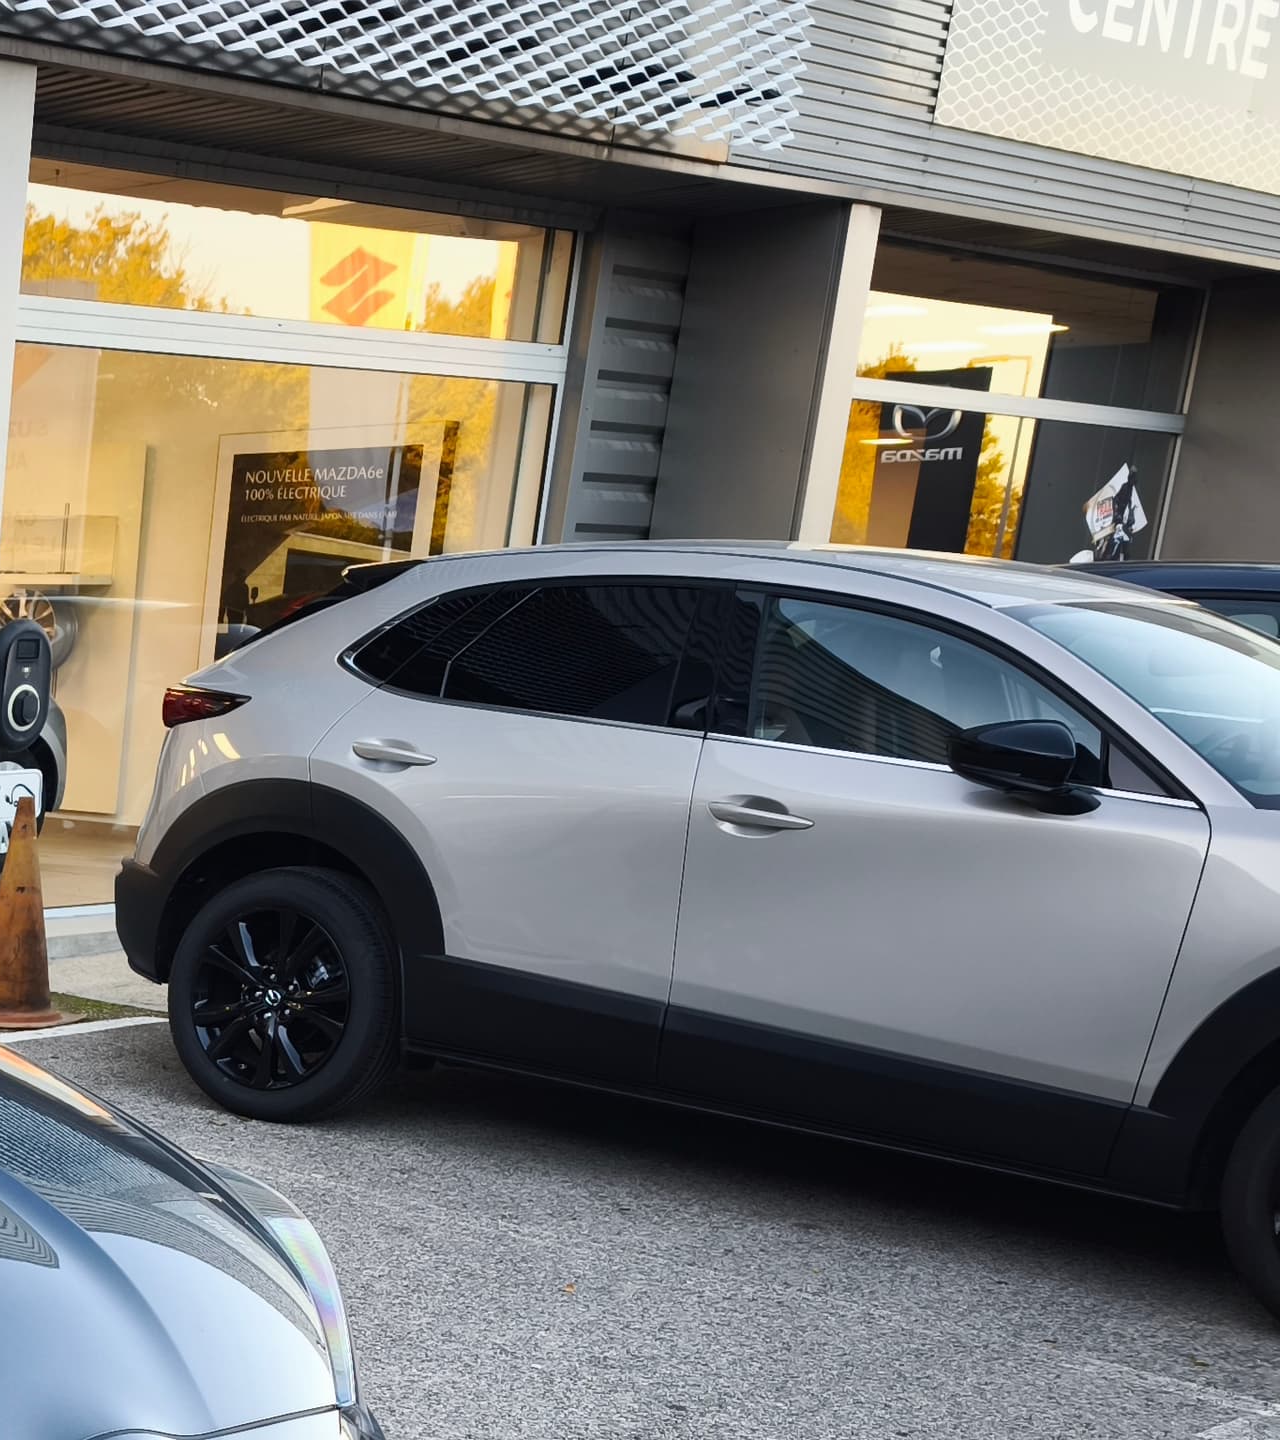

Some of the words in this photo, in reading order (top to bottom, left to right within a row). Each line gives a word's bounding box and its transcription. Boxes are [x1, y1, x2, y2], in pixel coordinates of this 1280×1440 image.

[245, 468, 312, 484] NOUVELLE
[313, 465, 384, 482] MAZDA6e
[244, 488, 274, 501] 100%
[277, 485, 347, 500] ÉLECTRIQUE
